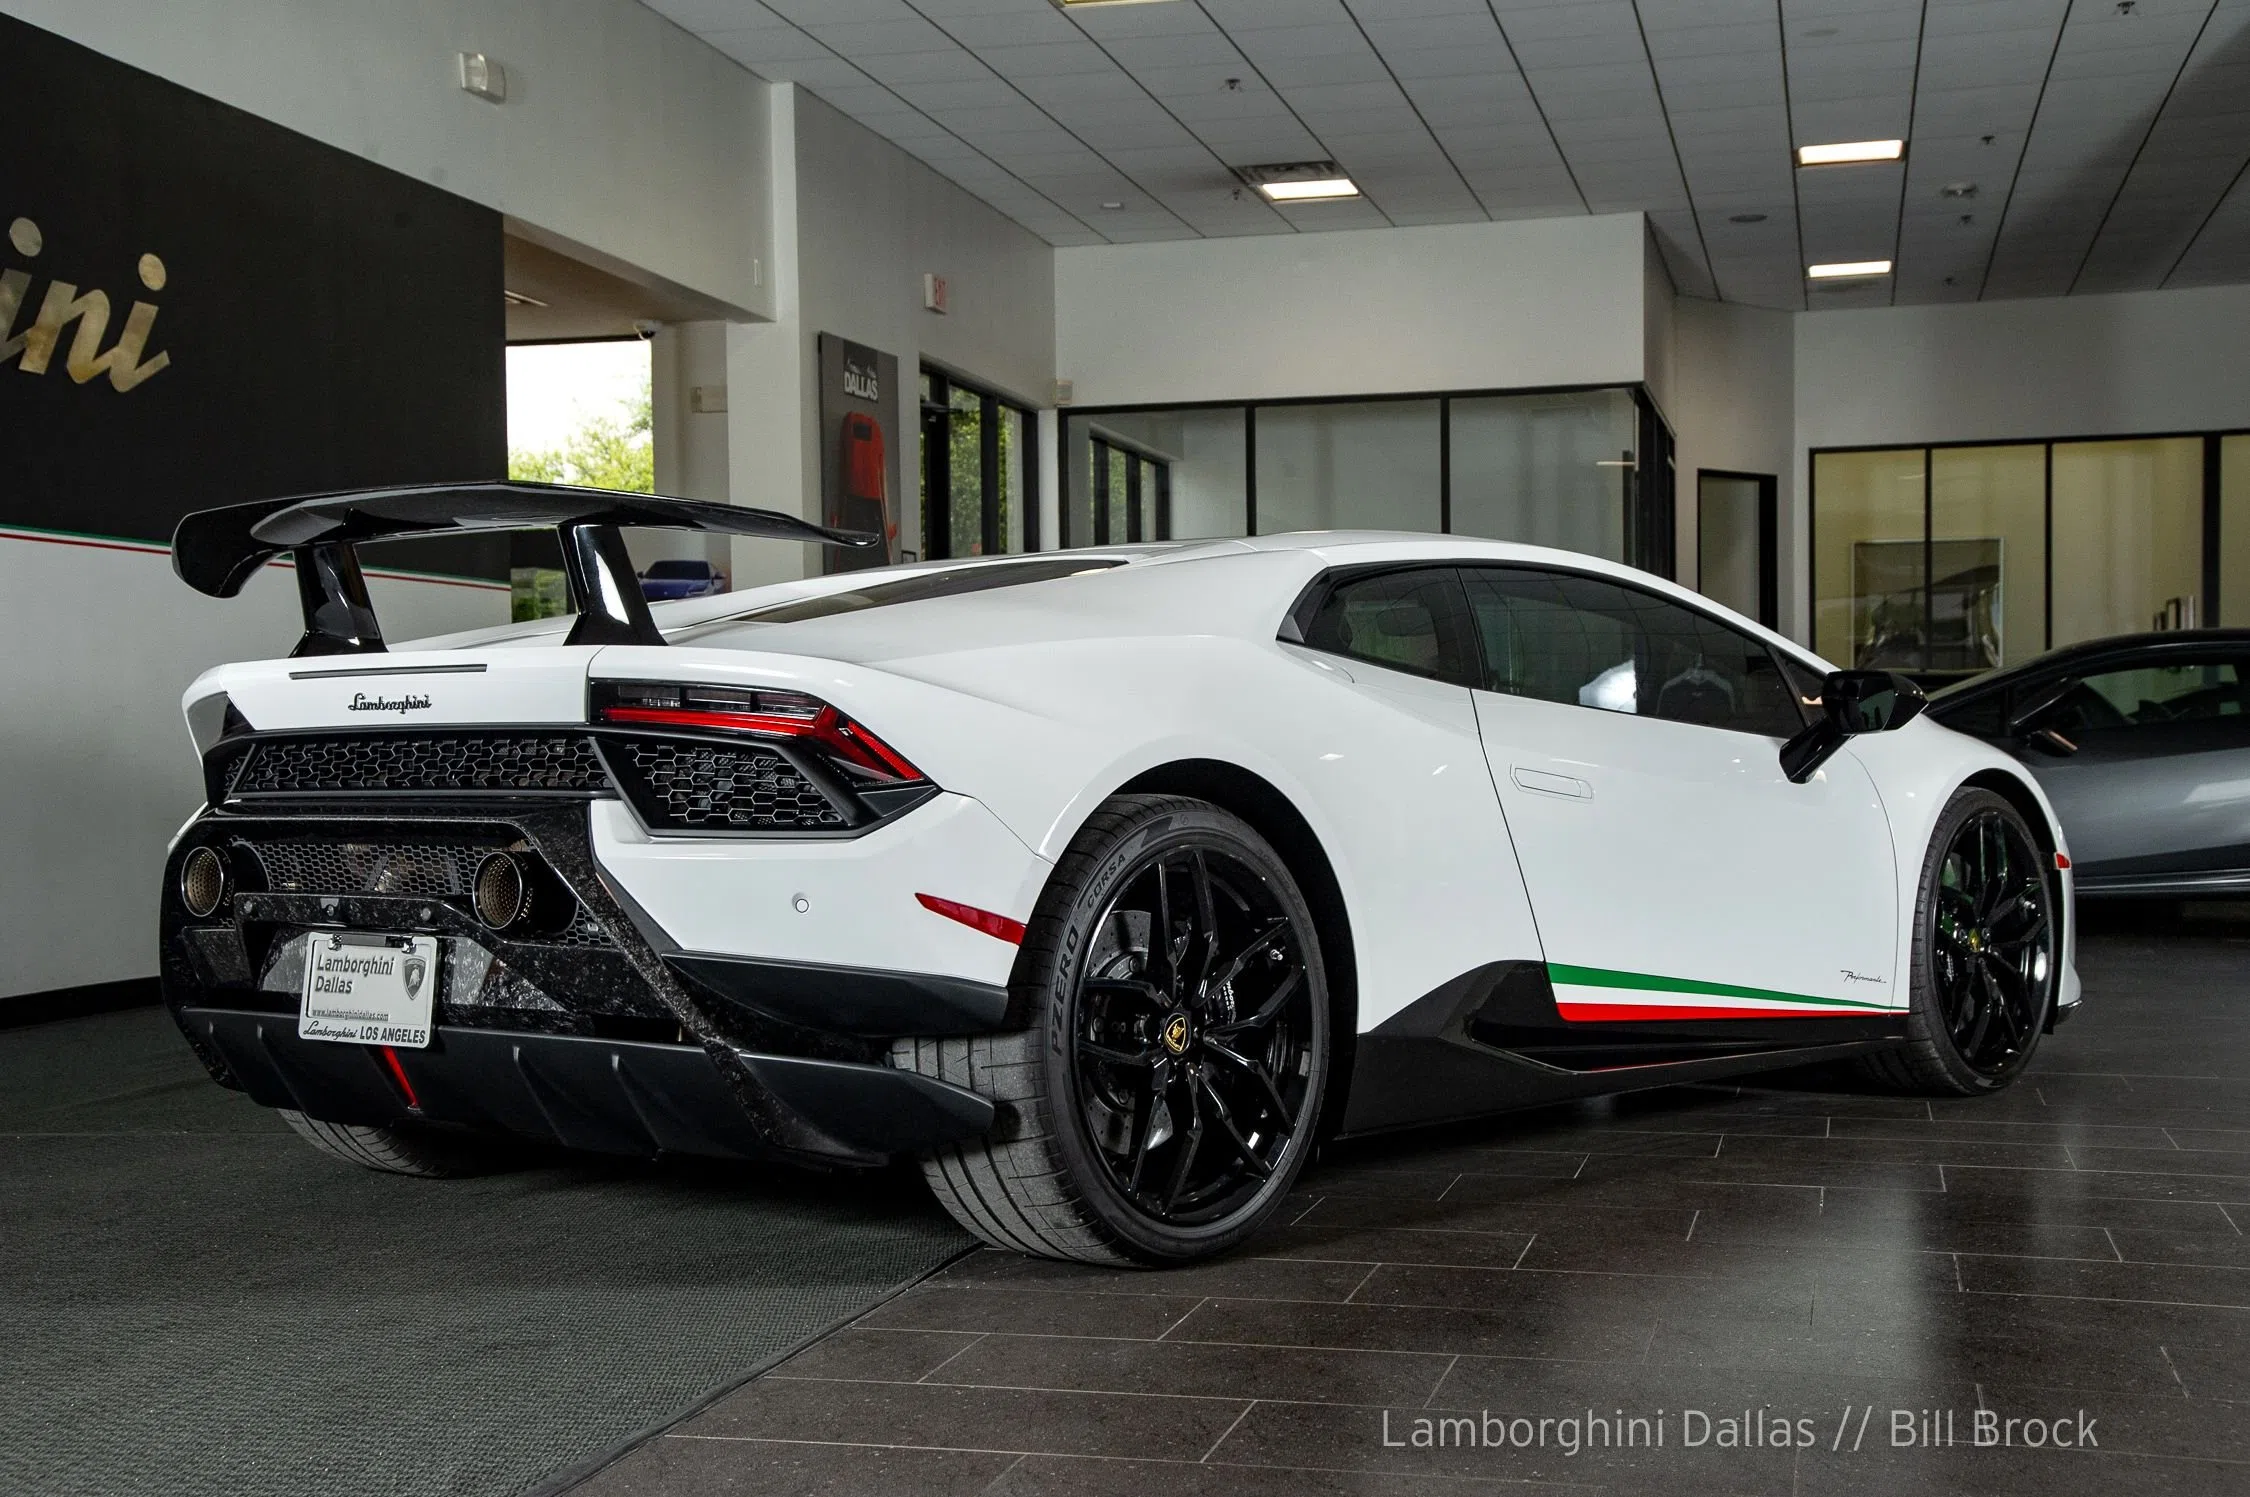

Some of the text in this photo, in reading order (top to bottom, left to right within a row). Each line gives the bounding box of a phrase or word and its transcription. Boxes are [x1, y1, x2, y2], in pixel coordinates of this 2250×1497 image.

[844, 371, 878, 400] DALLAS
[348, 692, 432, 714] Lamborghini
[1087, 853, 1127, 909] CORSA
[317, 954, 395, 977] Lamborghini
[315, 976, 353, 994] Dallas
[303, 1020, 426, 1043] Lamborghini LOS ANGELES
